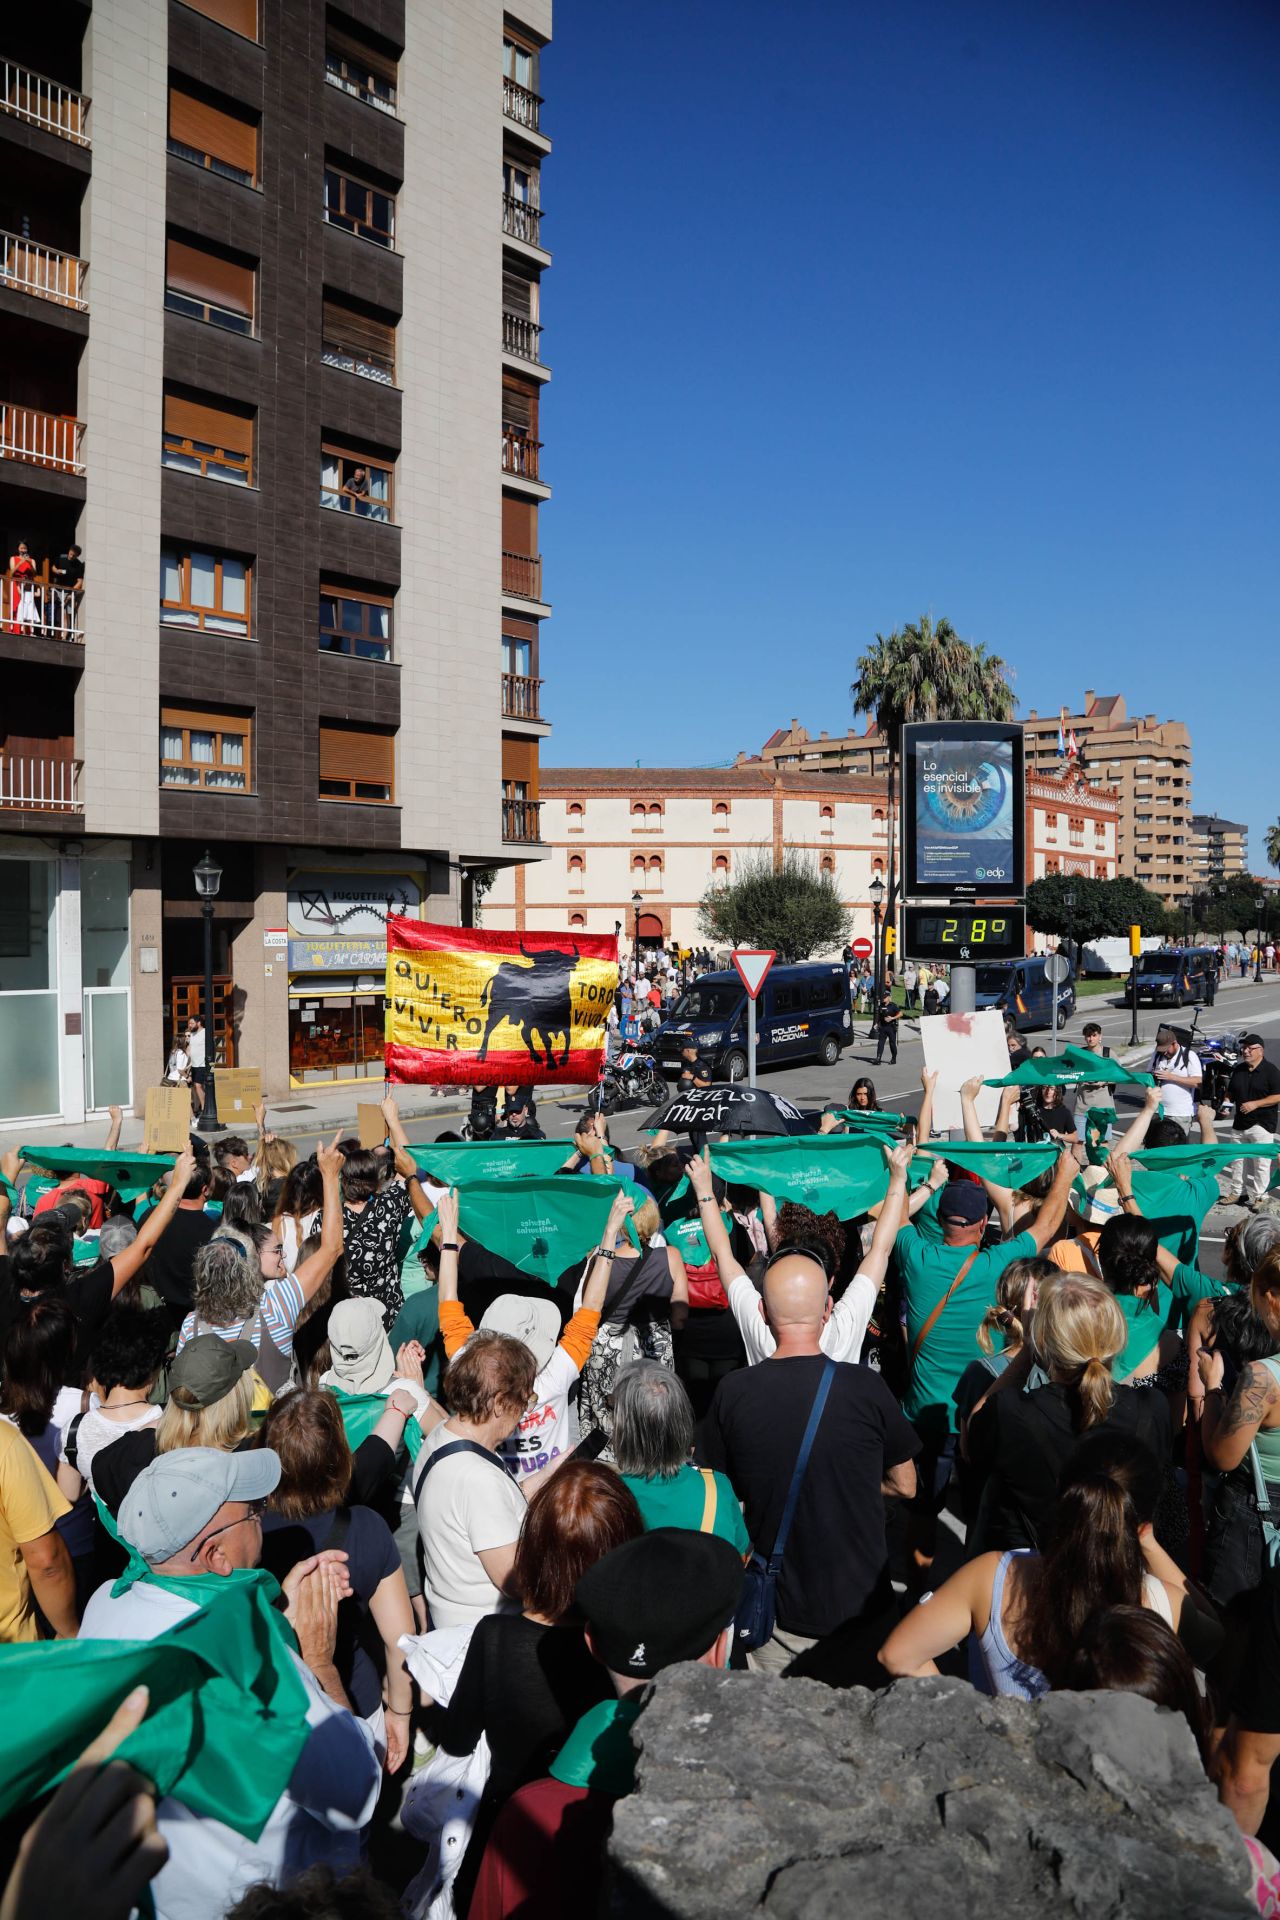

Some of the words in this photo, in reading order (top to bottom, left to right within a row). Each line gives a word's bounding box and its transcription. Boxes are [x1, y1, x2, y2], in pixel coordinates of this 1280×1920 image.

[923, 760, 937, 770] Lo
[923, 771, 968, 782] esencial
[923, 784, 936, 793] es
[938, 782, 981, 793] invisible
[986, 867, 1005, 879] edp
[349, 952, 387, 965] CARME
[578, 981, 614, 1005] TORO
[574, 1008, 602, 1028] VIVO
[771, 1024, 802, 1036] POLICIA
[771, 1031, 809, 1044] NACIONAL
[515, 1435, 543, 1452] ES
[503, 1446, 561, 1475] TURA
